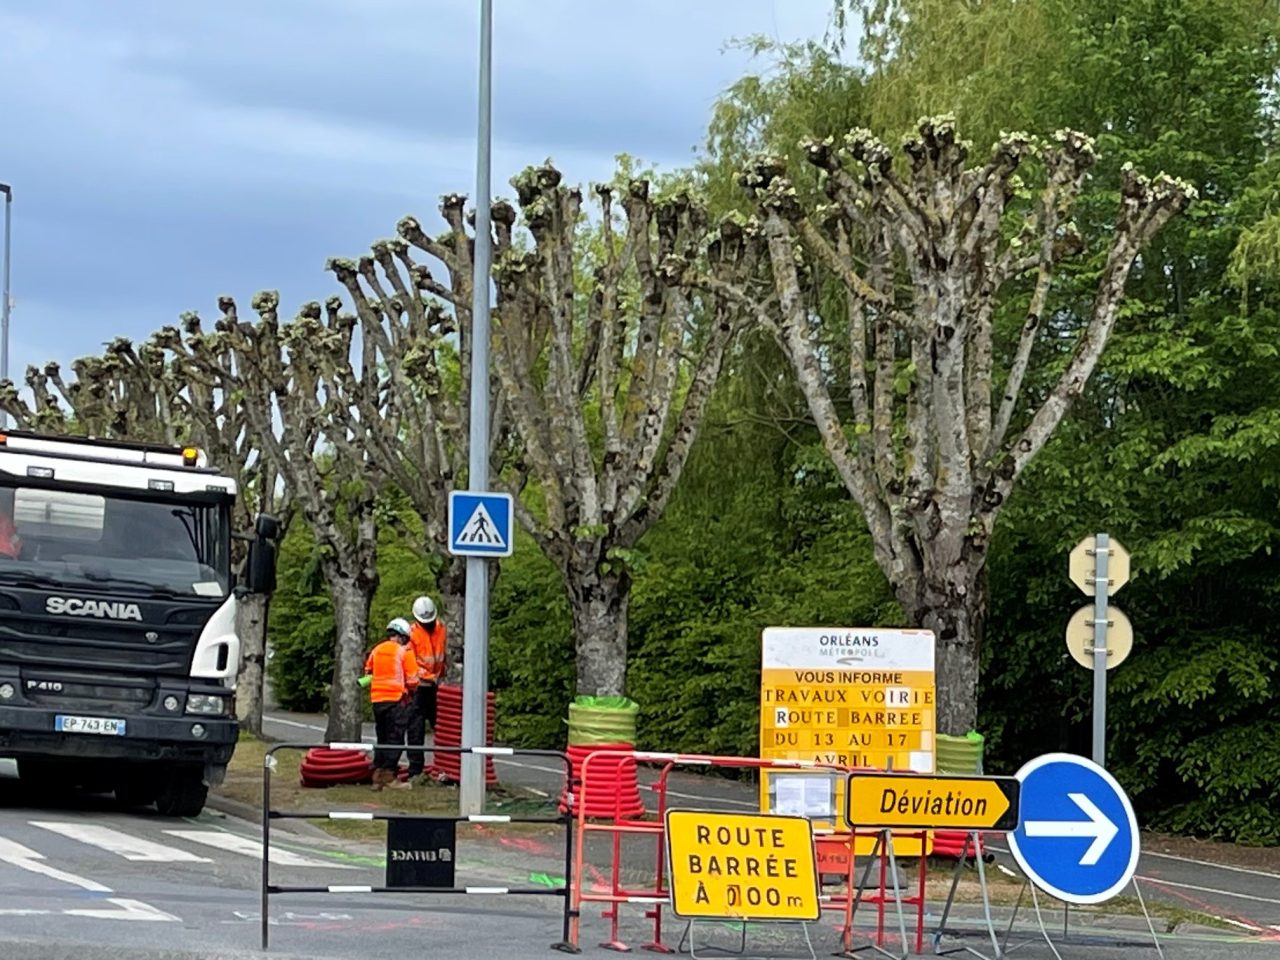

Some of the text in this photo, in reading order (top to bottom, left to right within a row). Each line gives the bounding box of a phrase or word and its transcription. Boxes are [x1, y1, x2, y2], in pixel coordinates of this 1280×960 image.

[46, 597, 143, 621] SCANIA
[819, 633, 879, 647] ORLÉANS
[795, 671, 903, 684] VOUS INFORME
[764, 690, 933, 704] TRAVAUX VOIRIE
[777, 711, 921, 725] ROUTE BARREE
[775, 733, 907, 747] DU 13 AU 17
[814, 754, 872, 767] AVRIL
[880, 788, 987, 816] Déviation
[697, 825, 785, 848] ROUTE
[688, 854, 798, 878] BARRÉE
[695, 880, 710, 904] À
[787, 895, 803, 907] m
